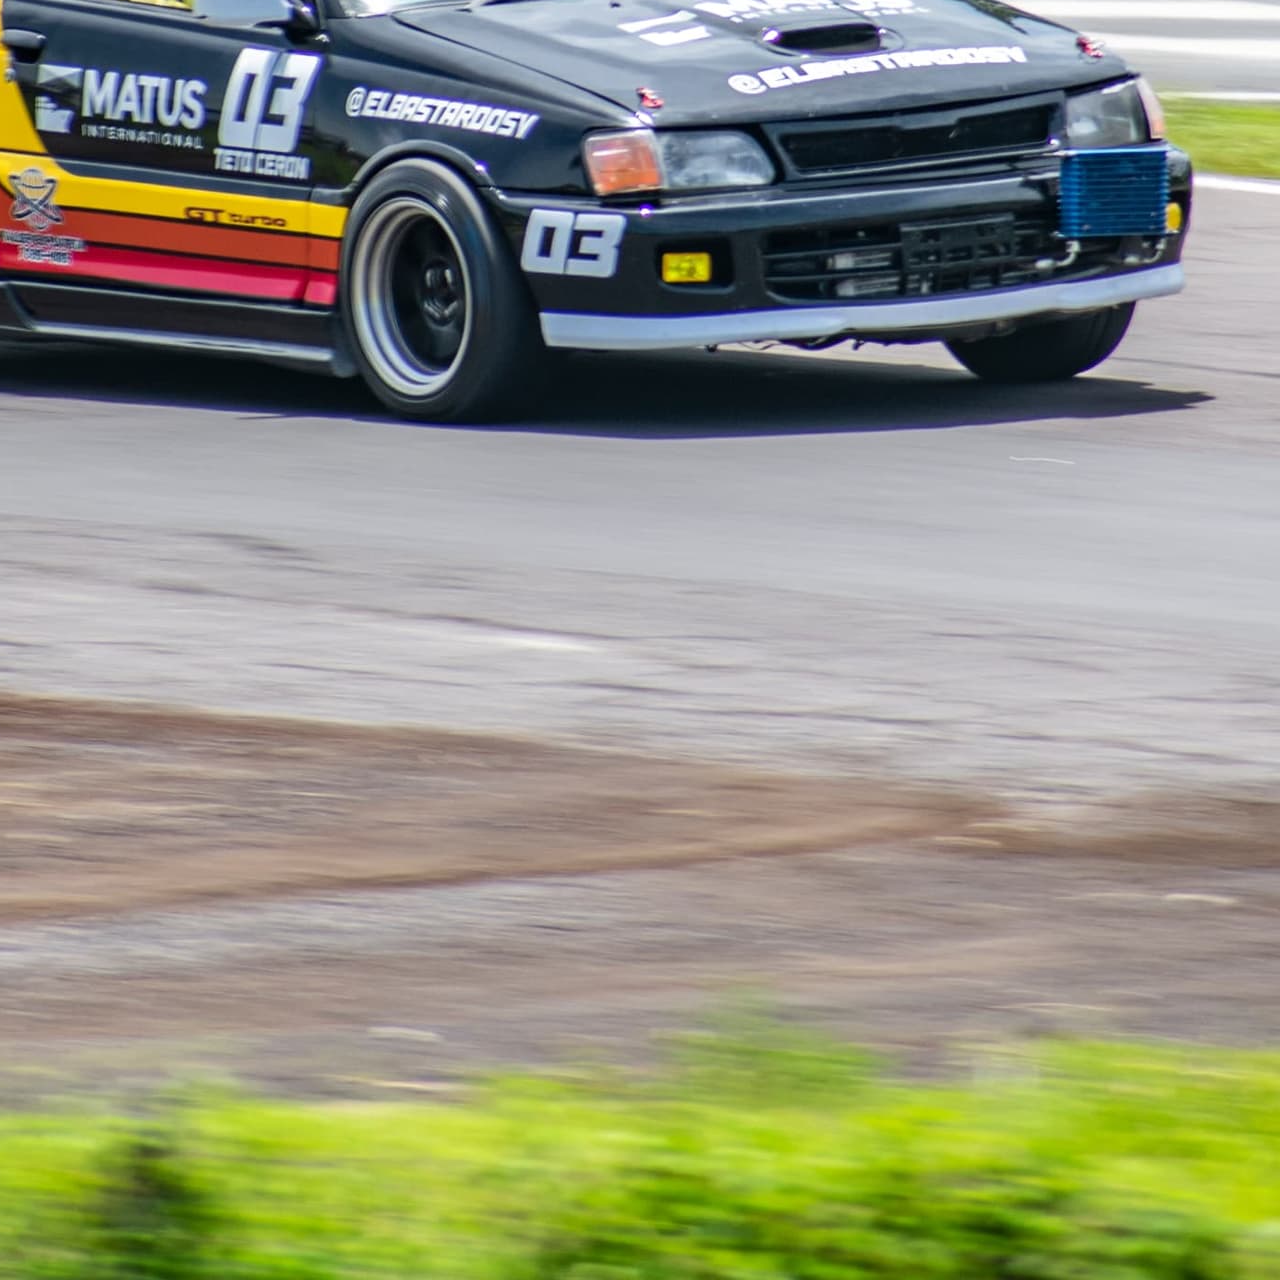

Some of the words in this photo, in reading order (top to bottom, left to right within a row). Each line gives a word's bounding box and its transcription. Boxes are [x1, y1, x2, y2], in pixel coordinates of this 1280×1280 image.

[81, 69, 208, 130] MATUS
[217, 47, 321, 153] 03
[345, 86, 540, 140] @ELBASTARDOSY
[81, 123, 204, 150] INTERNATIONAL
[214, 147, 253, 172] TETO
[255, 153, 311, 180] CERON
[184, 207, 225, 221] GT
[229, 212, 287, 228] turbo
[520, 208, 627, 278] 03
